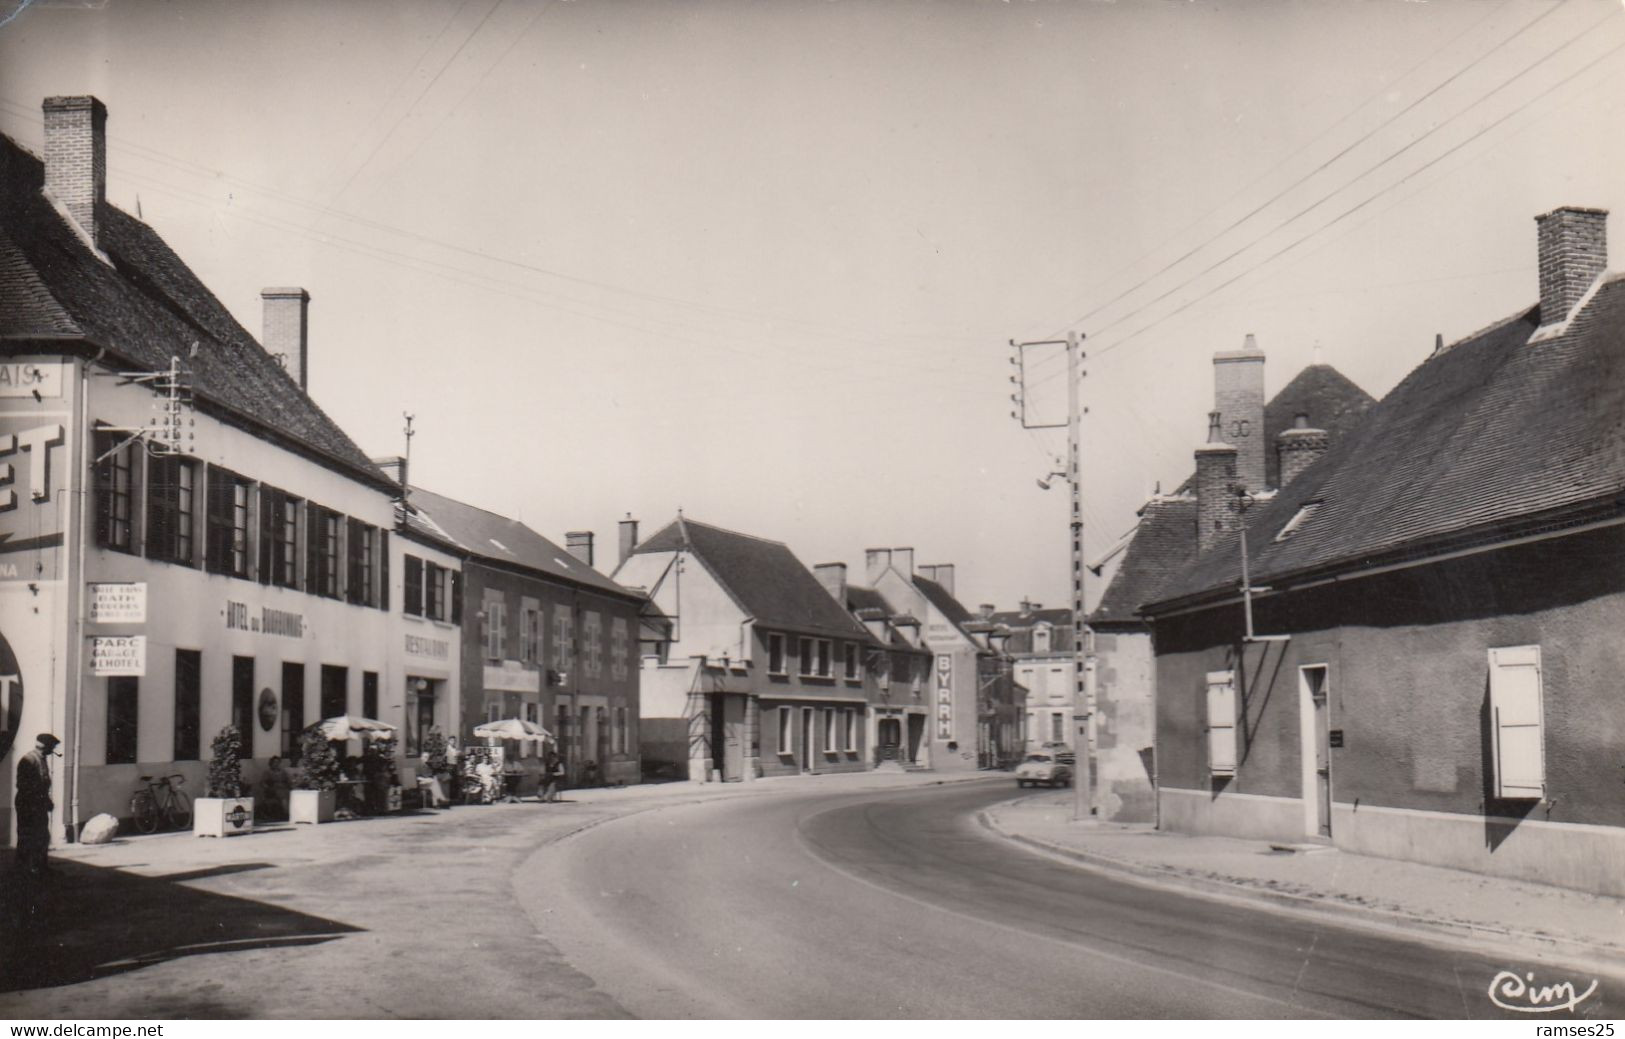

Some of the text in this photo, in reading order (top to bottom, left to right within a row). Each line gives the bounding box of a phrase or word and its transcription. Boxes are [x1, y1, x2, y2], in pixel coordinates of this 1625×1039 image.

[94, 639, 139, 647] PARC
[405, 634, 449, 660] RESTAURANT
[938, 656, 950, 736] BYRRH
